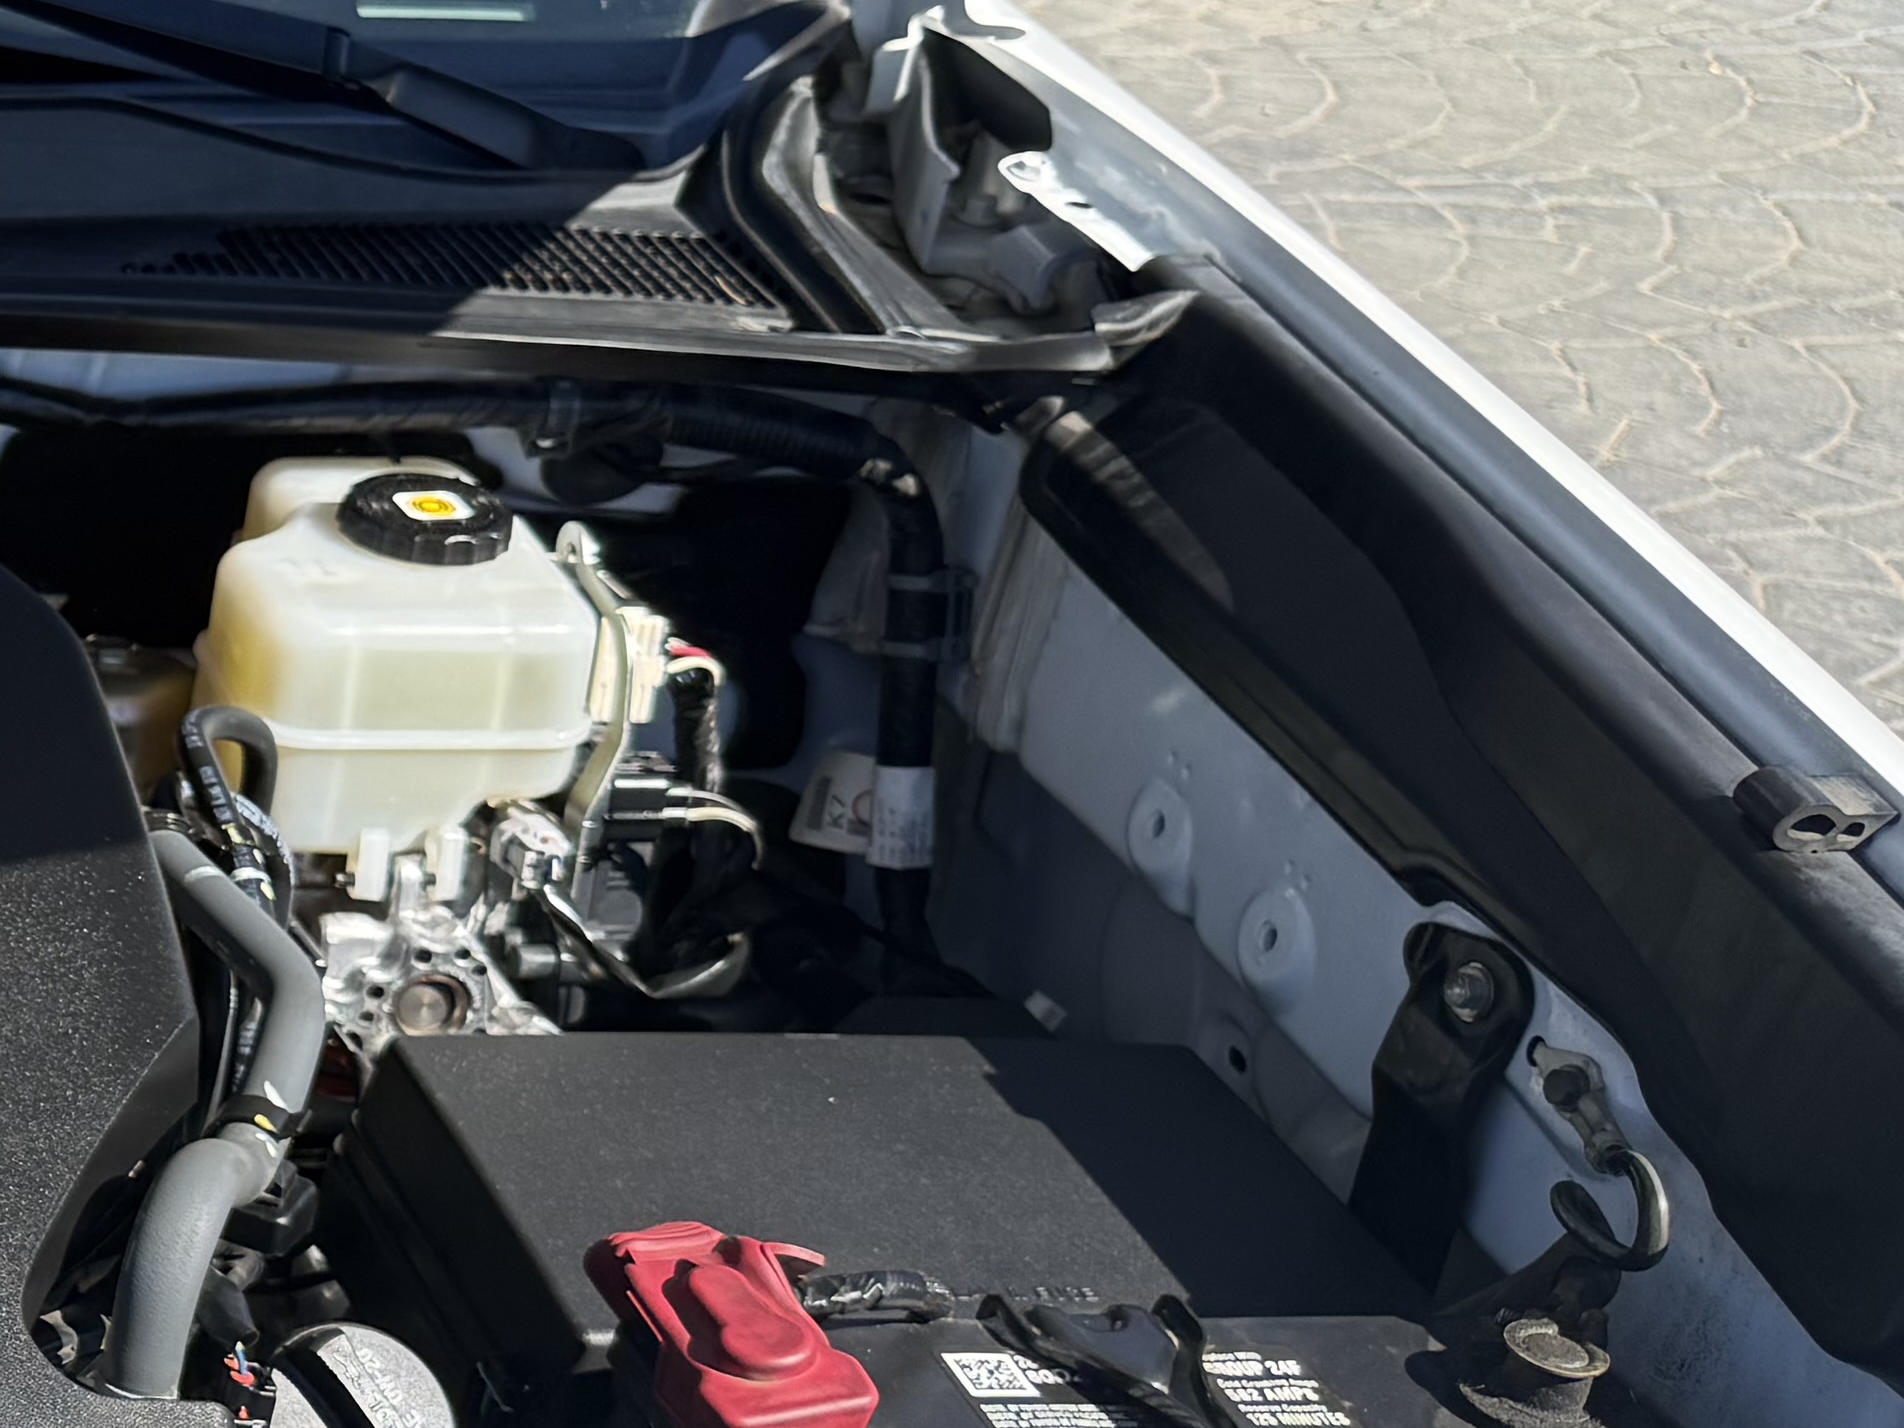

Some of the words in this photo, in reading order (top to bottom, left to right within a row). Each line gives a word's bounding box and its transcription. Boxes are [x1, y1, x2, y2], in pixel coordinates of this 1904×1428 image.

[1202, 1361, 1263, 1376] GROUP
[1264, 1360, 1301, 1376] 24F
[1263, 1387, 1319, 1401] AMPS
[1276, 1412, 1351, 1426] MINUTES
